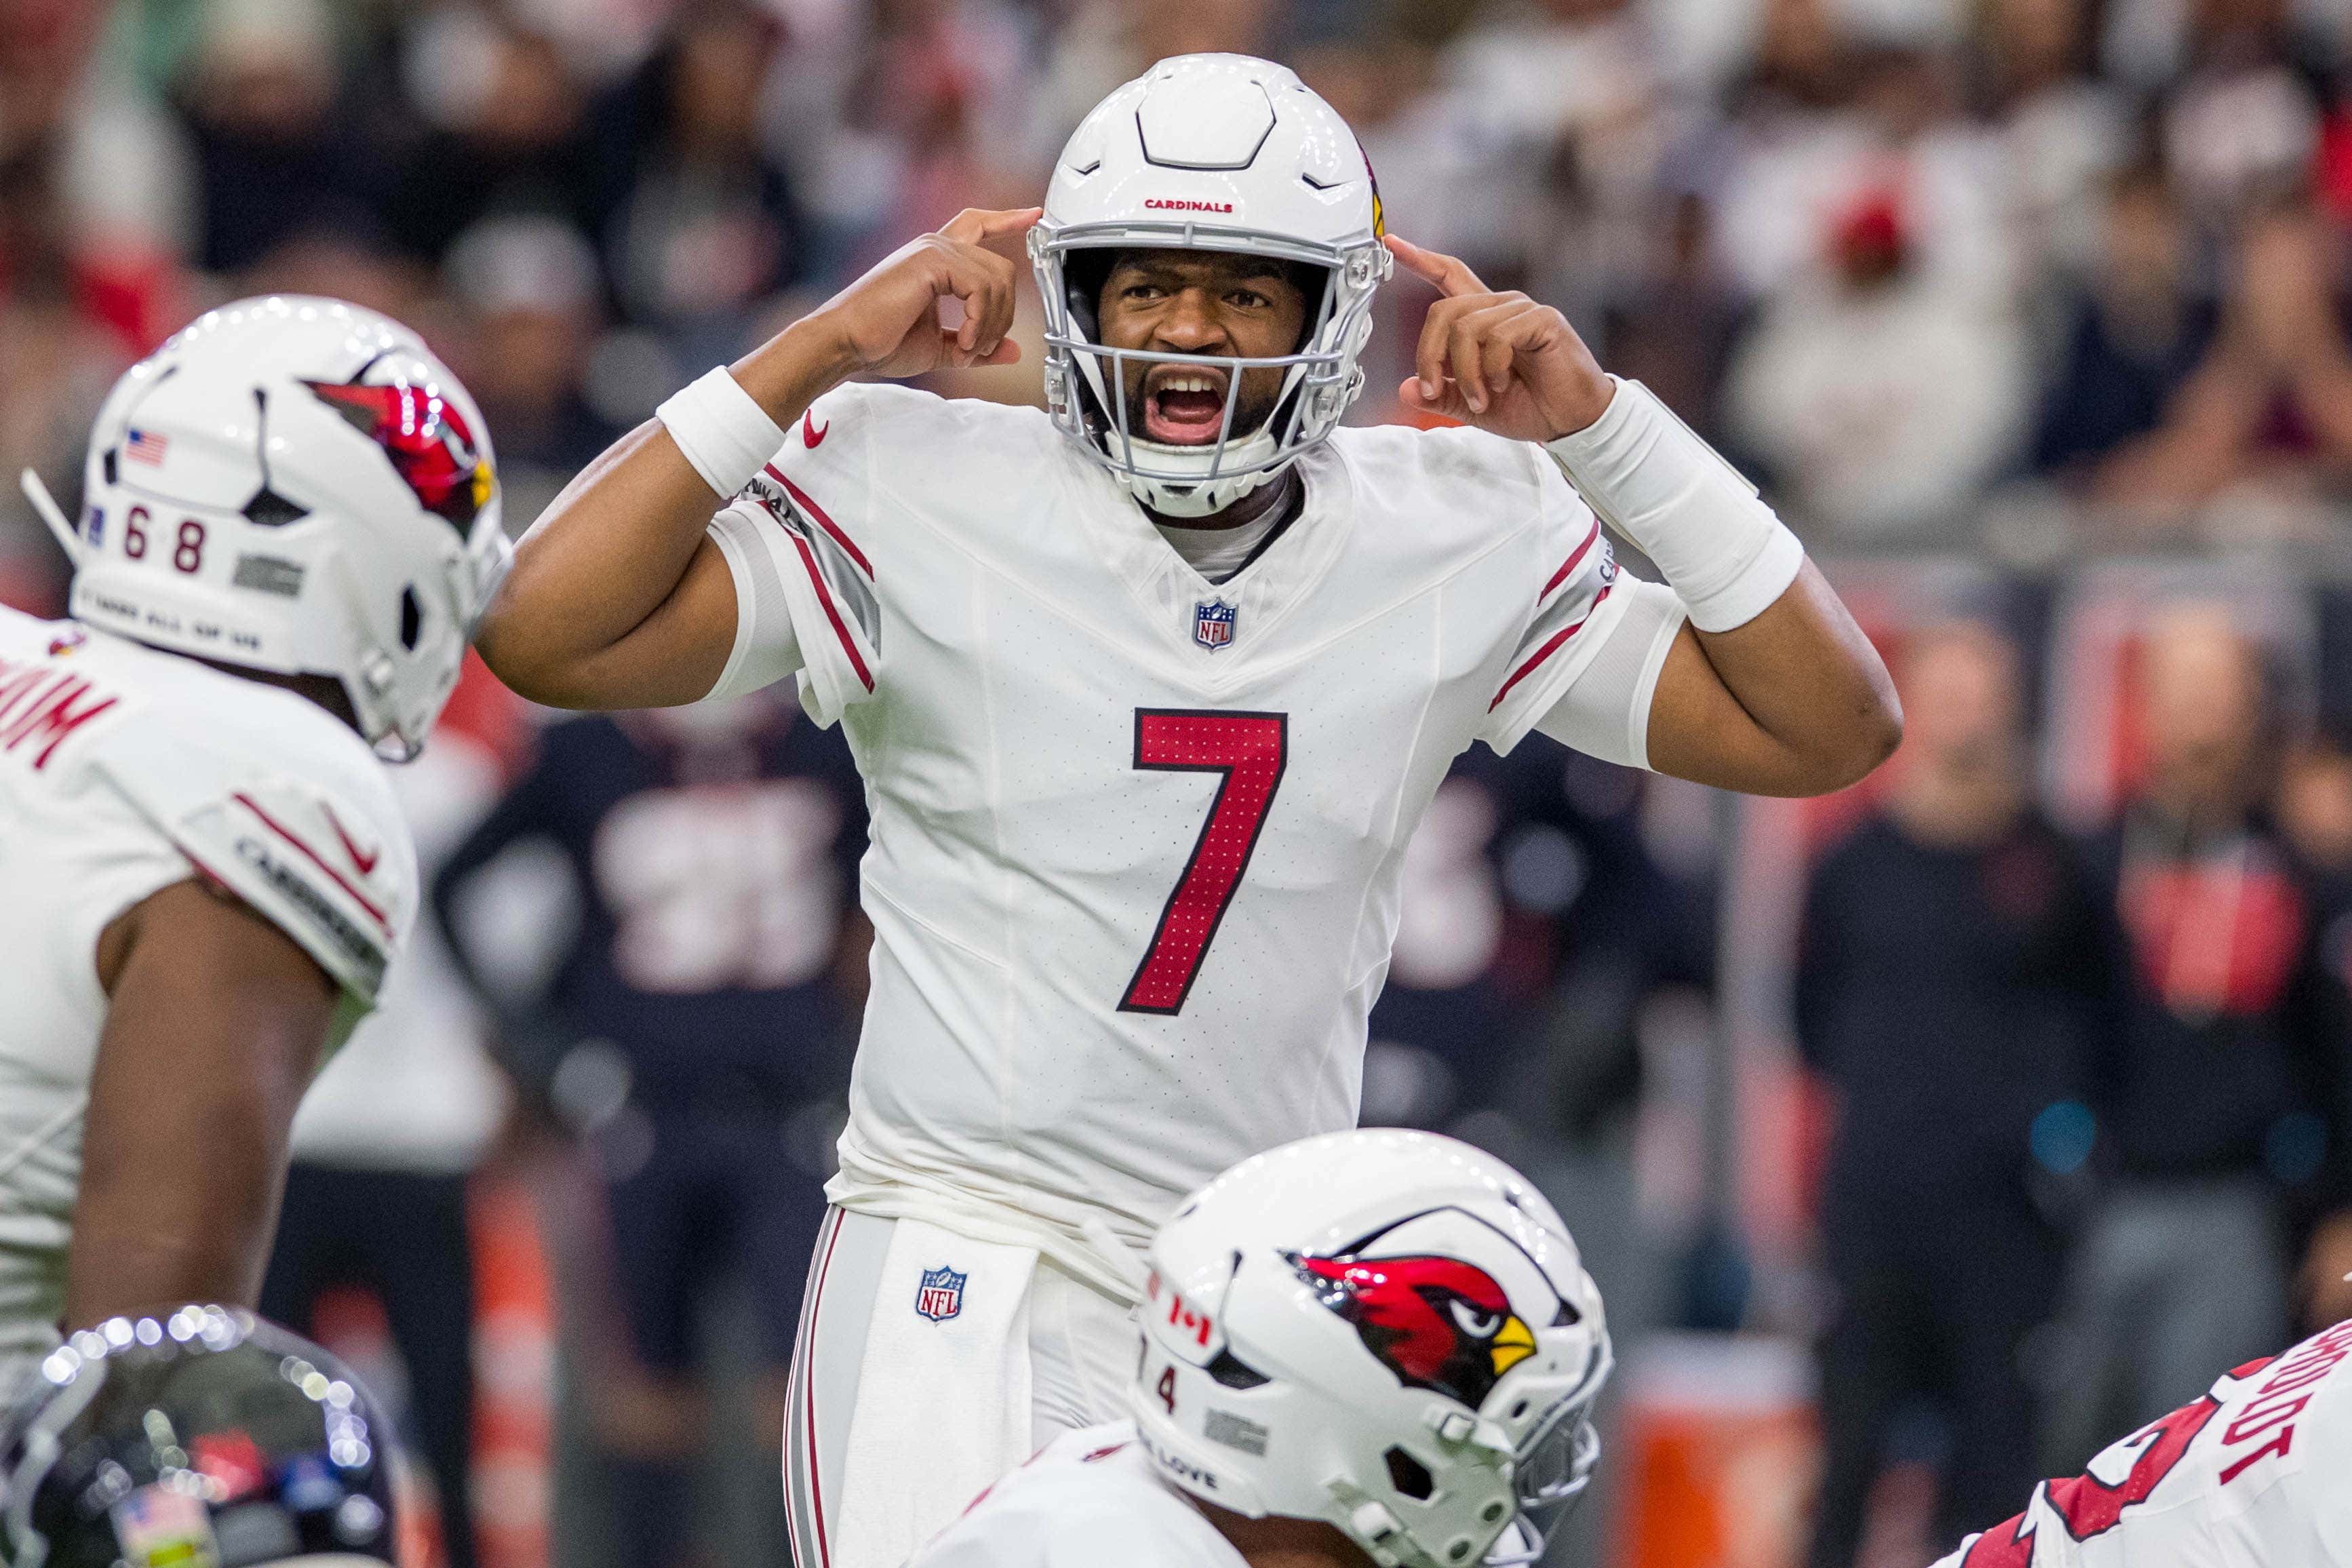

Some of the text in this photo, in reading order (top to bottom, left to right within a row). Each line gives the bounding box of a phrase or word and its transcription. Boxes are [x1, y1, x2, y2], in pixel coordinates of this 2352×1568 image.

[1144, 199, 1233, 214] CARDINALS
[125, 507, 205, 574] 68
[1200, 621, 1228, 643] NFL
[1116, 707, 1288, 1016] 7
[921, 1289, 957, 1316] NFL
[1158, 1447, 1217, 1489] LOVE
